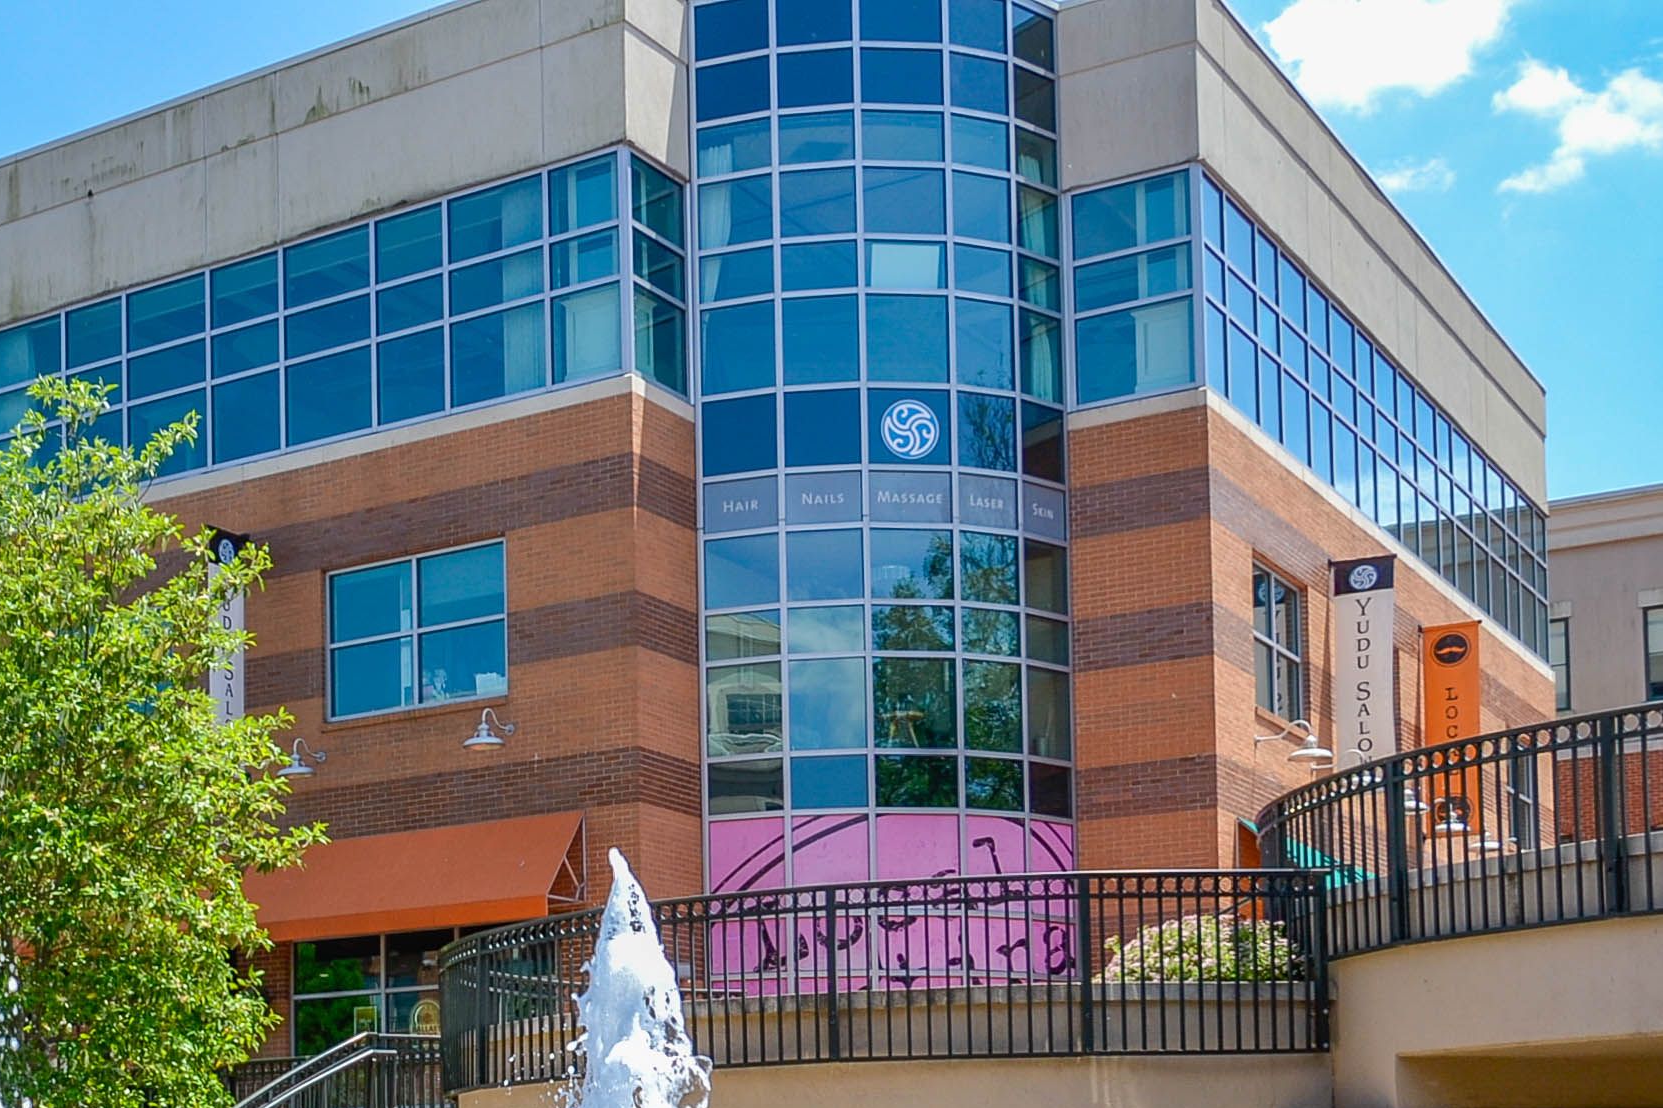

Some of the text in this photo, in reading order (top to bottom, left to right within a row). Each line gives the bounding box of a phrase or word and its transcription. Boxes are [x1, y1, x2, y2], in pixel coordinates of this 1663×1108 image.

[722, 490, 1054, 520] HAIR NAILS MASSAGE LASER SKIN
[1355, 597, 1371, 669] YUDU
